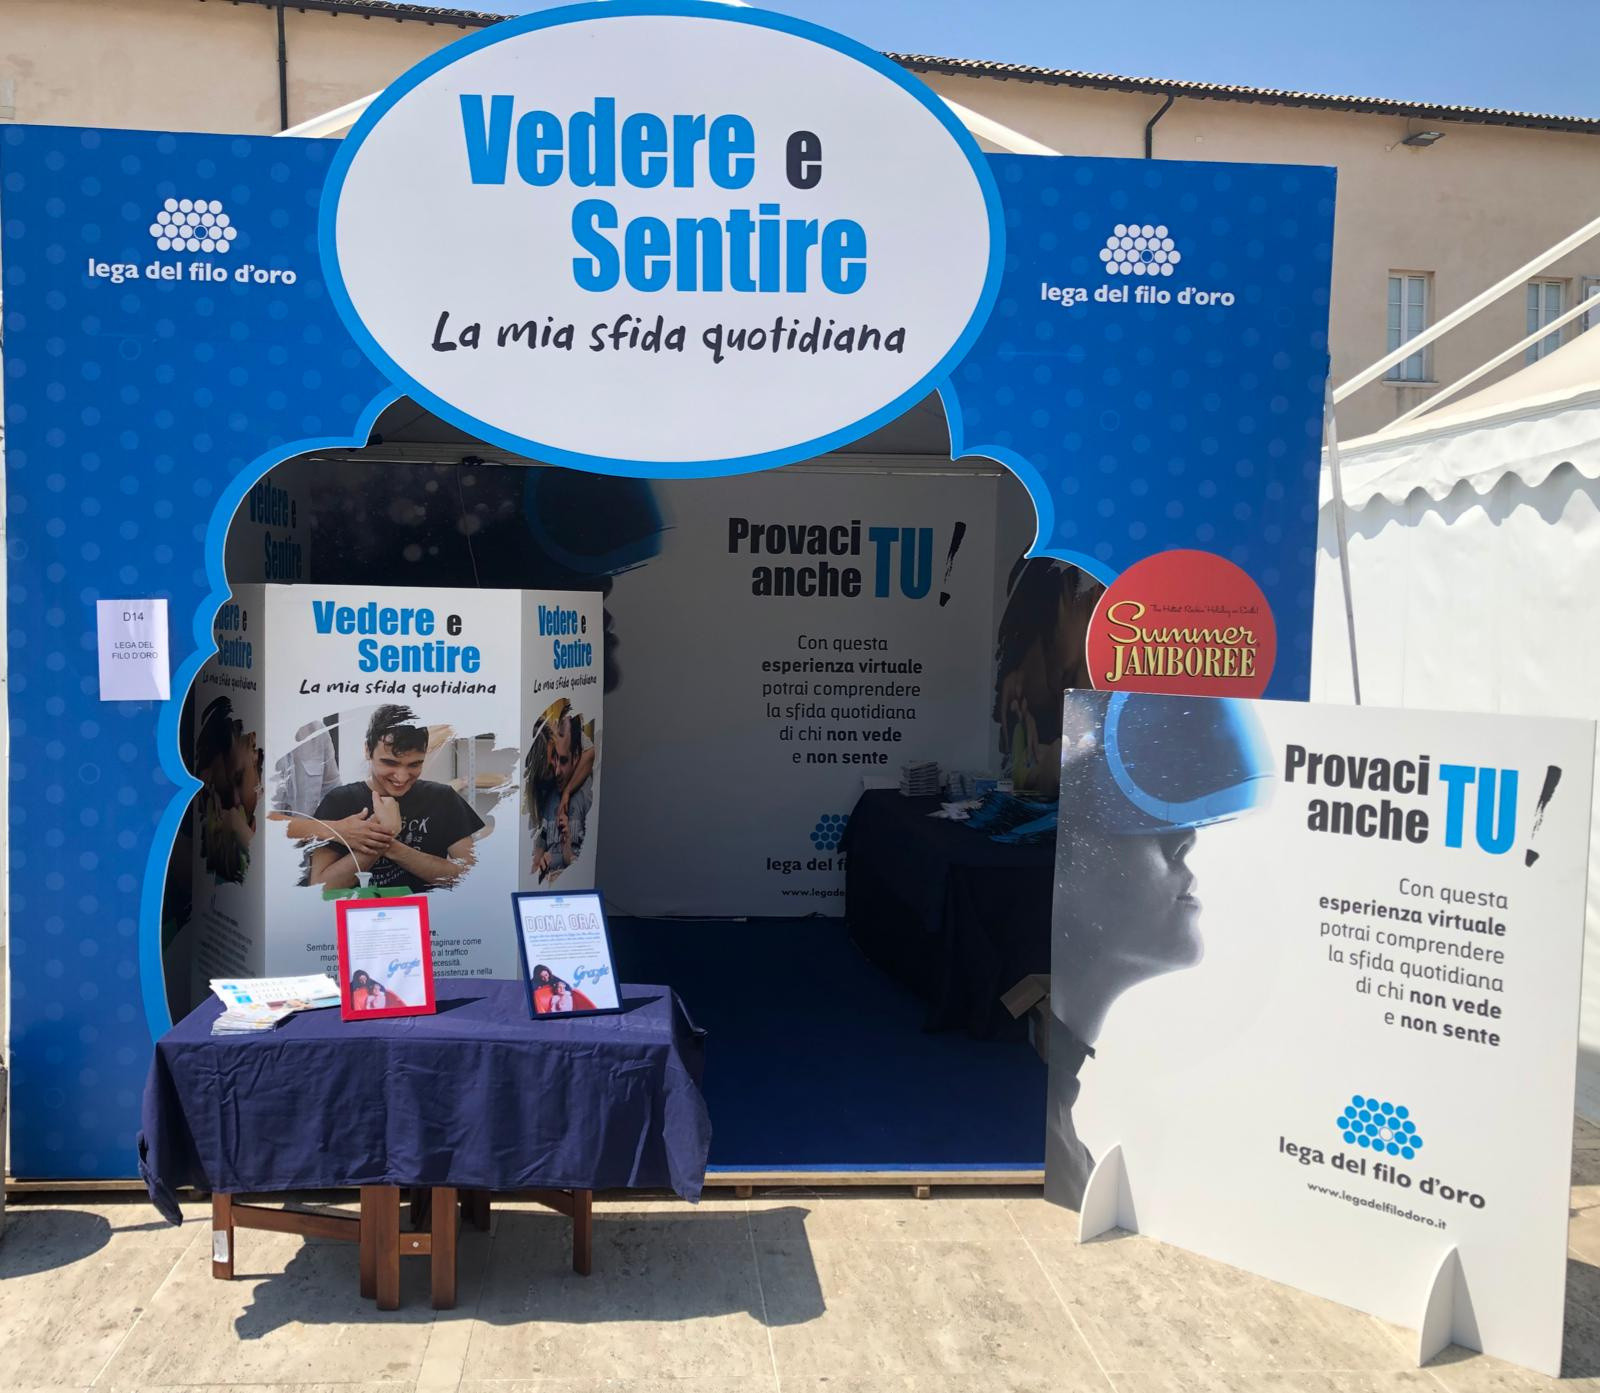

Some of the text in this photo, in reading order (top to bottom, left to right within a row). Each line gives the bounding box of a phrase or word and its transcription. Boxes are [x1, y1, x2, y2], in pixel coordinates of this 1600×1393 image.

[459, 94, 823, 190] Vedere e
[571, 198, 867, 295] Sentire
[88, 258, 297, 285] lega del filo d'oro
[1041, 282, 1235, 307] lega del filo d'oro
[431, 310, 906, 364] La mia sfida quotidiana
[291, 499, 297, 528] e
[728, 517, 861, 556] Provaci
[264, 531, 303, 580] Sentire
[751, 561, 862, 598] anche
[123, 612, 144, 622] D14
[242, 610, 247, 632] e
[312, 600, 462, 636] Vedere e
[538, 605, 587, 636] Vedere e
[1106, 600, 1257, 645] Summer
[218, 633, 253, 669] Sentire
[358, 638, 481, 673] Sentire
[553, 639, 592, 670] Sentire
[798, 634, 888, 652] Con questa
[761, 657, 923, 675] esperienza virtuale
[1106, 645, 1257, 682] JAMBOREE
[299, 679, 497, 698] La mia sfida quotidiana
[534, 674, 597, 693] La mia sfida quotidiana
[762, 681, 921, 698] potrai comprendere
[767, 702, 916, 721] la sfida quotidiana
[779, 726, 902, 742] di chi non vede
[792, 750, 888, 764] e non sente
[1284, 744, 1430, 795] Provaci
[1307, 798, 1429, 844] anche
[767, 858, 848, 874] lega del fi
[1399, 878, 1508, 910] Con questa
[525, 913, 600, 932] DONA ORA
[1319, 896, 1506, 936] esperienza virtuale
[445, 949, 469, 957] traffico
[462, 938, 482, 946] come
[1320, 921, 1504, 964] potrai comprendere
[1328, 945, 1504, 993] la sfida quotidiana
[1355, 976, 1502, 1019] di chi non vede
[1384, 1010, 1501, 1047] e non sente
[1279, 1136, 1486, 1210] lega del filo d'oro
[1307, 1181, 1447, 1230] www.legadelfilodoro.it
